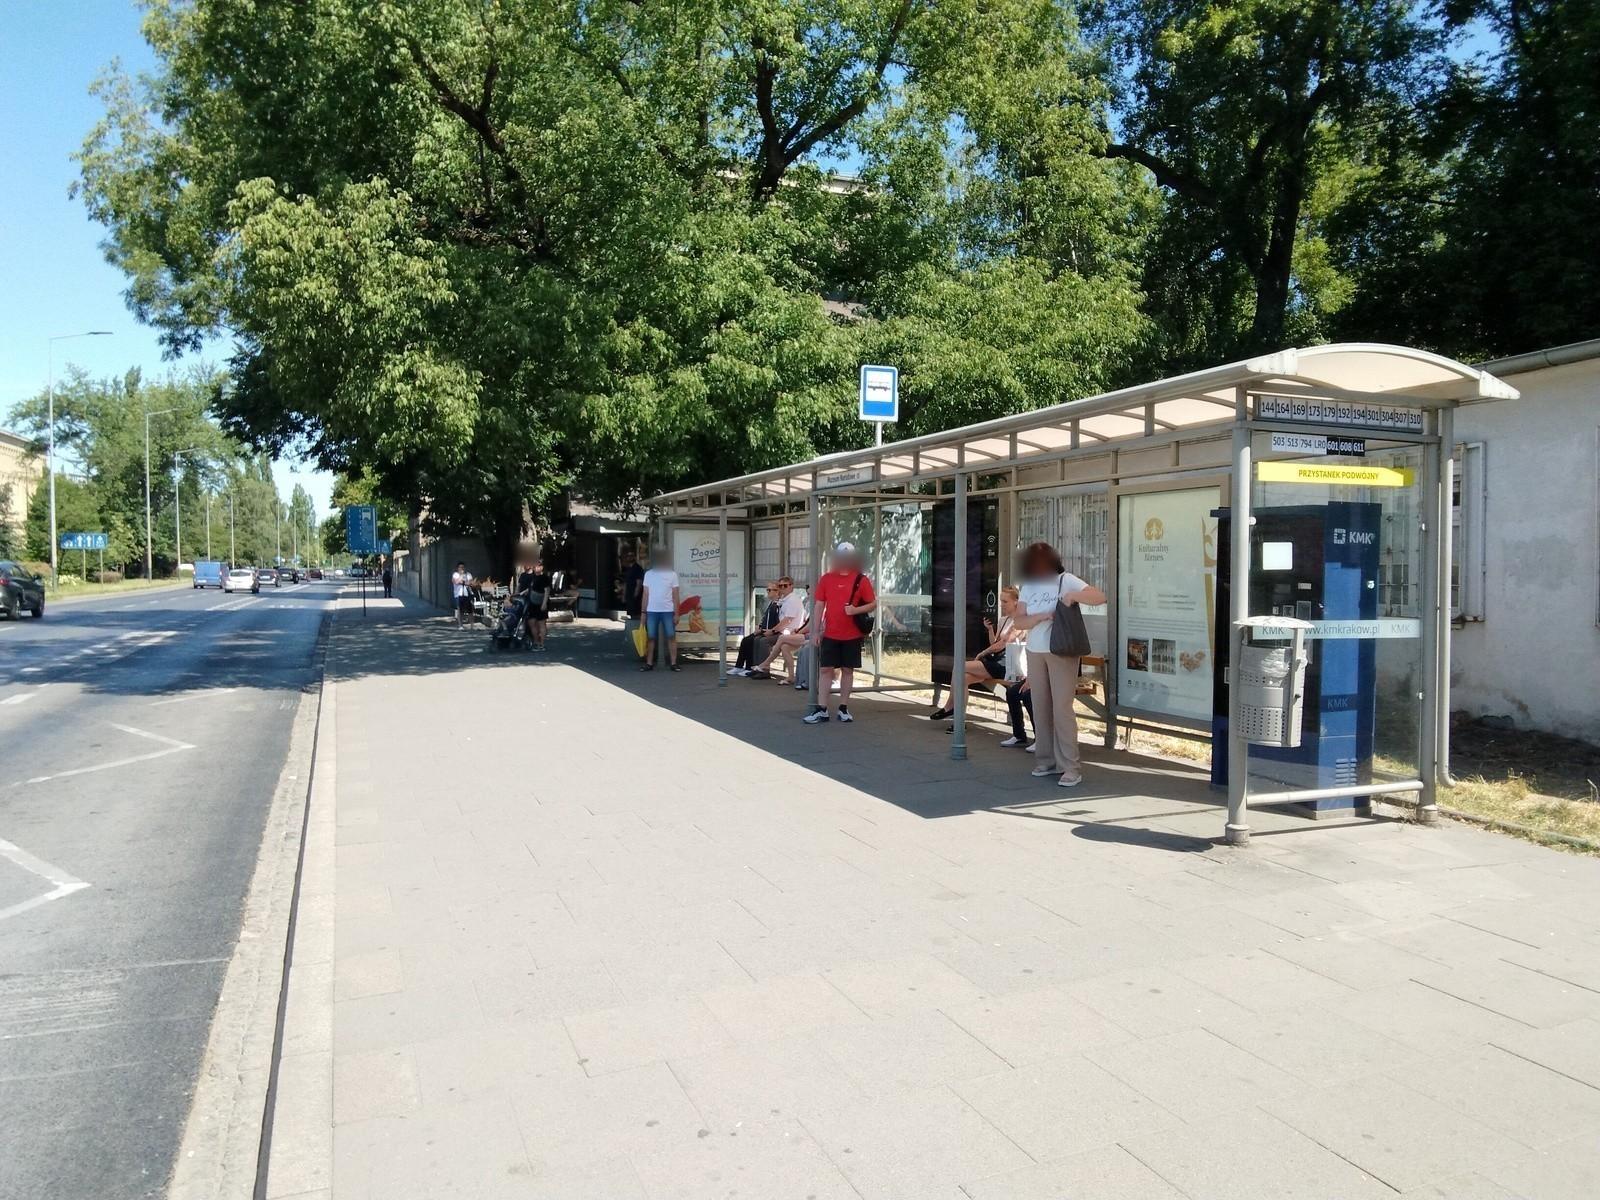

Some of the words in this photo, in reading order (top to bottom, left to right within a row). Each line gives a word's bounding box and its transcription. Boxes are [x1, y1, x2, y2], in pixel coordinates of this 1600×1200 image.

[1262, 402, 1274, 413] 144
[1277, 403, 1290, 414] 164
[1293, 404, 1306, 415] 169
[1309, 406, 1320, 417] 173
[1324, 406, 1336, 418] 179
[1338, 408, 1350, 419] 192
[1353, 409, 1365, 420] 194
[1367, 410, 1379, 421] 301
[1382, 411, 1394, 422] 304
[1395, 412, 1407, 423] 307
[1410, 414, 1421, 424] 310
[1273, 436, 1285, 446] 503
[1287, 438, 1299, 448] 513
[1300, 439, 1312, 449] 794
[1327, 441, 1339, 451] 601
[1353, 443, 1364, 452] 611
[1299, 469, 1341, 479] PRZYSTANEK
[1349, 532, 1372, 545] KMK
[690, 546, 721, 561] Pogod
[1262, 626, 1285, 635] KMK
[1304, 624, 1380, 637] ww.kmkrakow.pl
[1391, 623, 1410, 634] KMK
[1327, 697, 1349, 709] KMK
